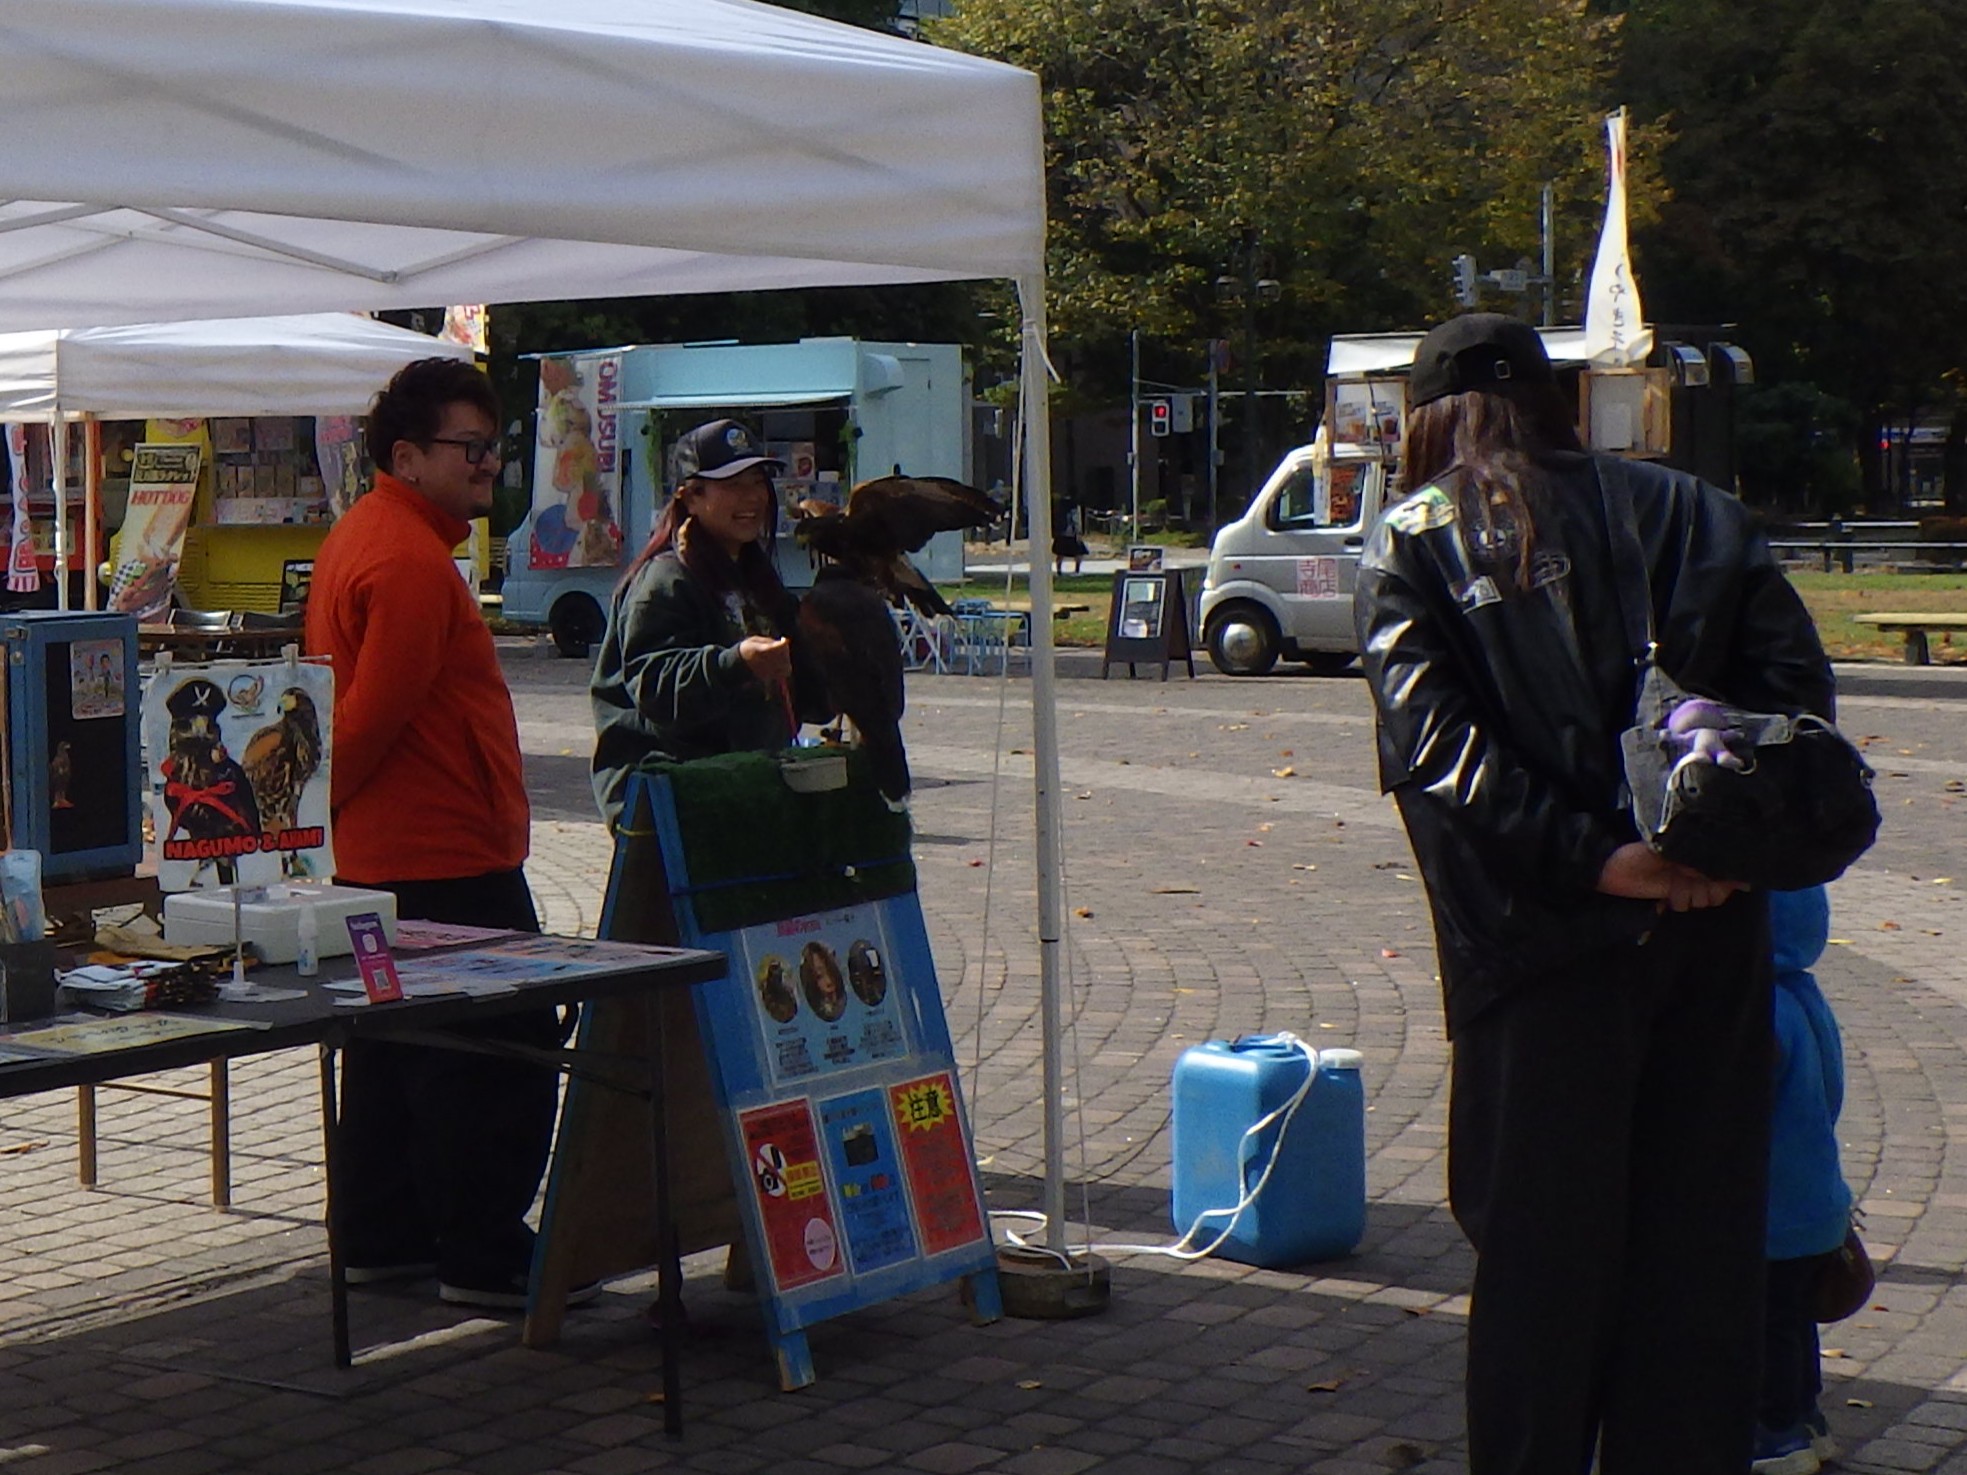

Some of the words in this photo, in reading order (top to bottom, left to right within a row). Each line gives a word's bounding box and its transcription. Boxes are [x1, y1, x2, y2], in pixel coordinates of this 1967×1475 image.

[165, 836, 257, 859] NAGUMO
[260, 833, 276, 851] &
[908, 1088, 943, 1122] 注意
